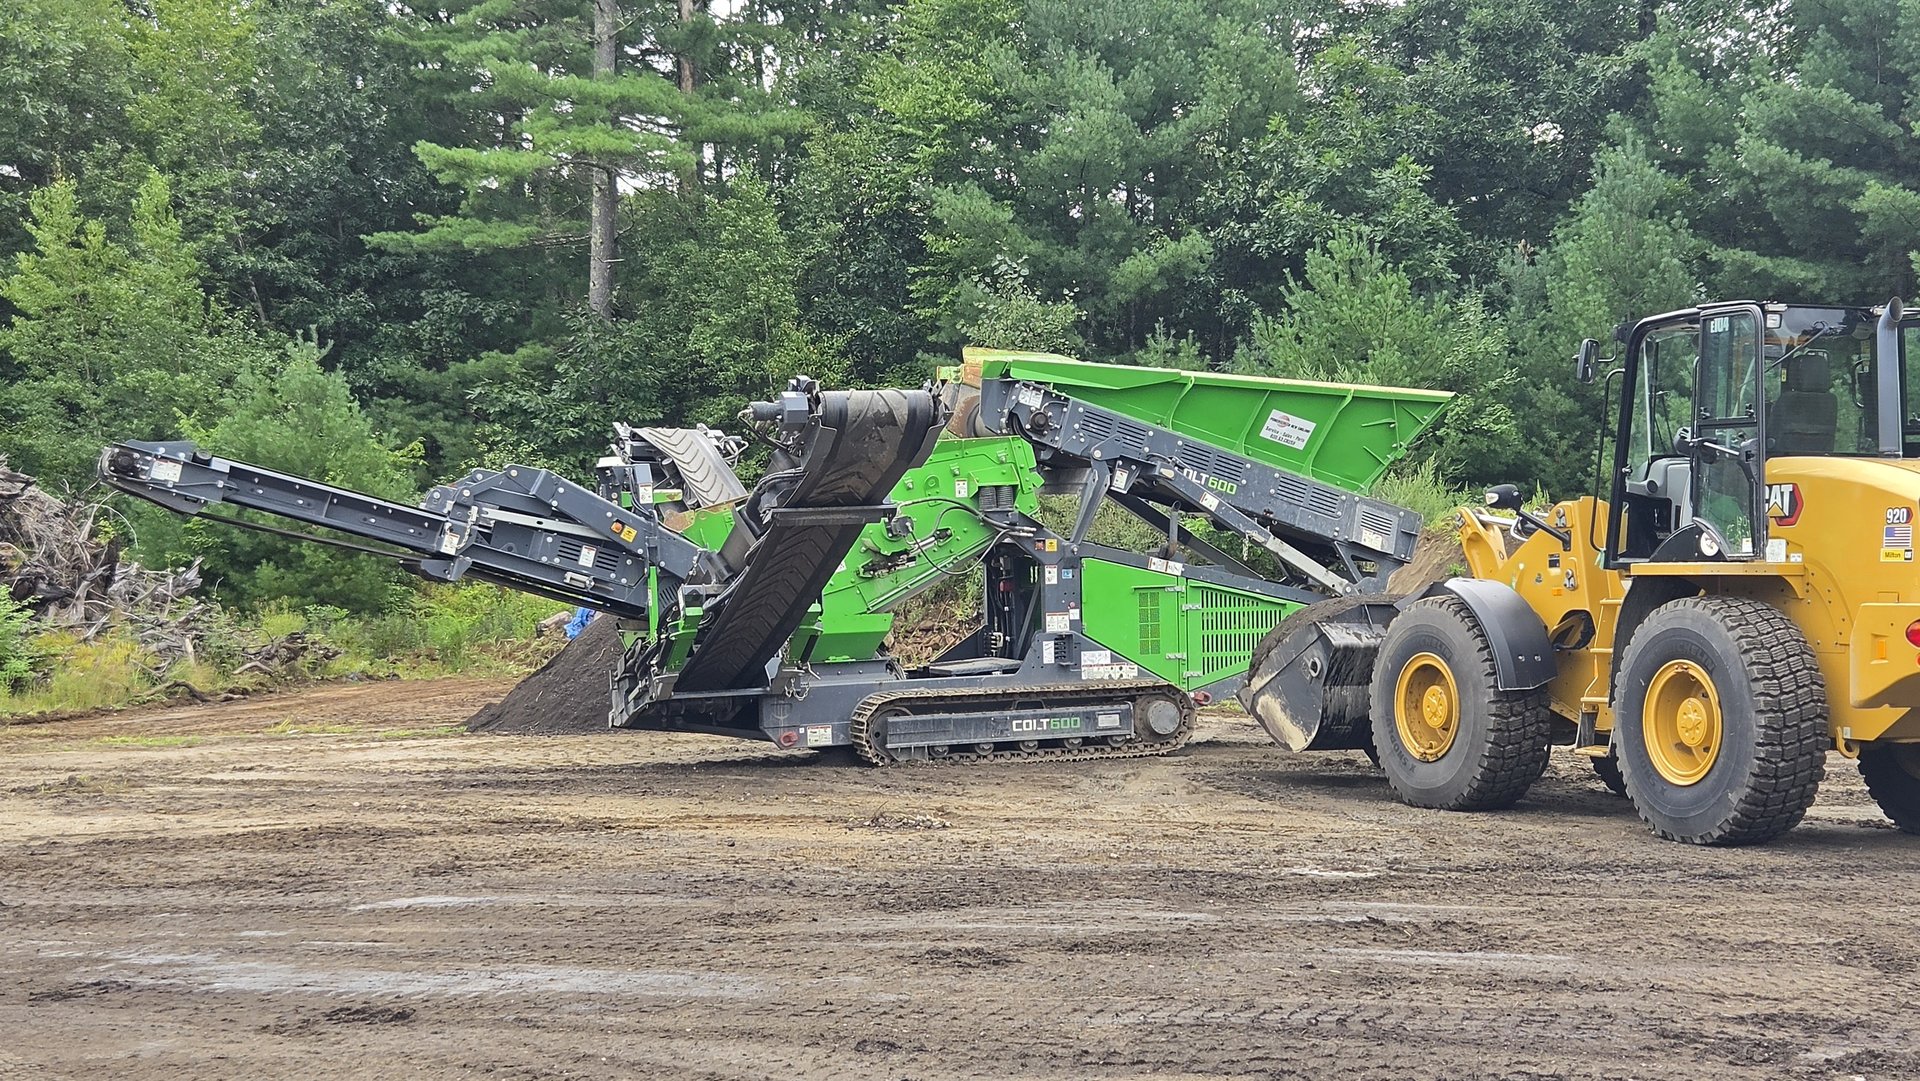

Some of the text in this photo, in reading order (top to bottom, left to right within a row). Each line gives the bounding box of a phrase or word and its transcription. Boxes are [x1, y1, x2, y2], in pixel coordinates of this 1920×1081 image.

[1183, 468, 1237, 495] OLT600
[1886, 507, 1908, 524] 920
[1012, 717, 1080, 732] COLT600
